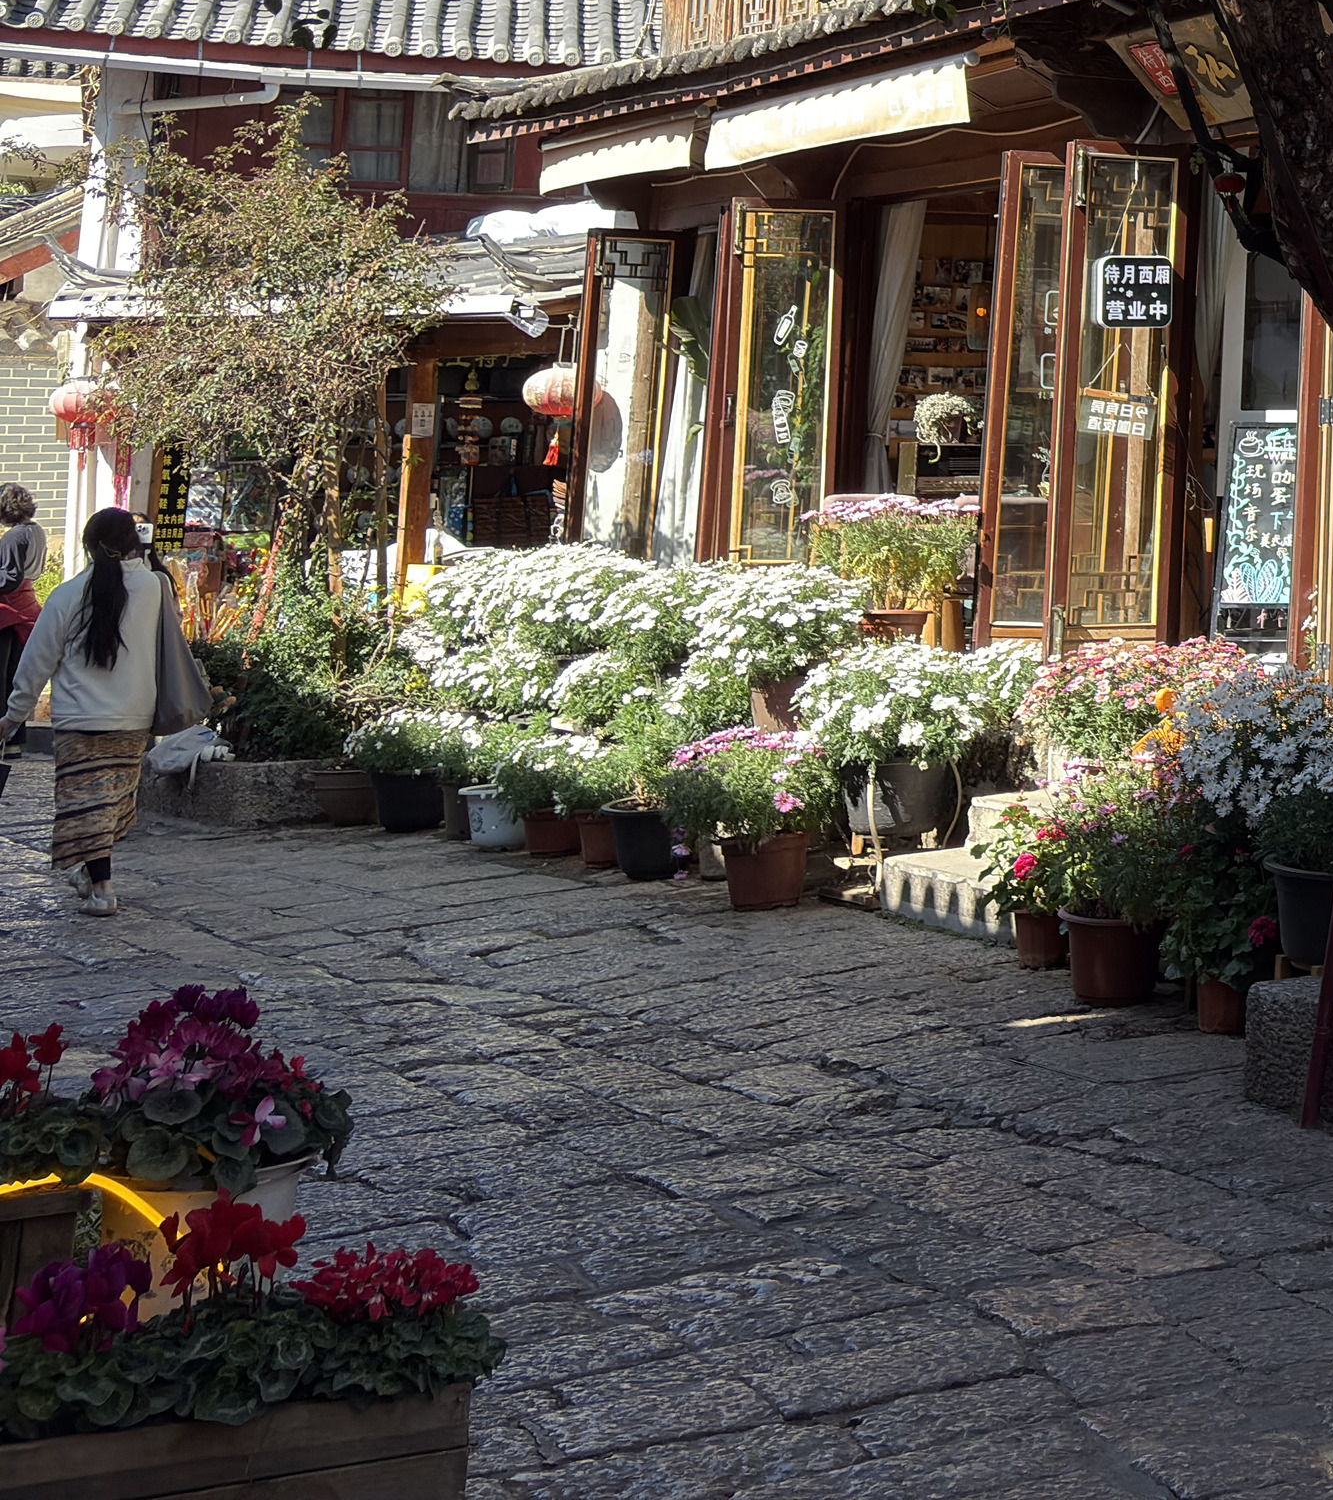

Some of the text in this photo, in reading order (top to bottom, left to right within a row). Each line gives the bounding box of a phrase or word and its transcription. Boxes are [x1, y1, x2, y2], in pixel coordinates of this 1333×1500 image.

[1104, 264, 1171, 285] 待月西厢
[1106, 300, 1168, 321] 营业中
[1242, 464, 1266, 542] 现场音乐
